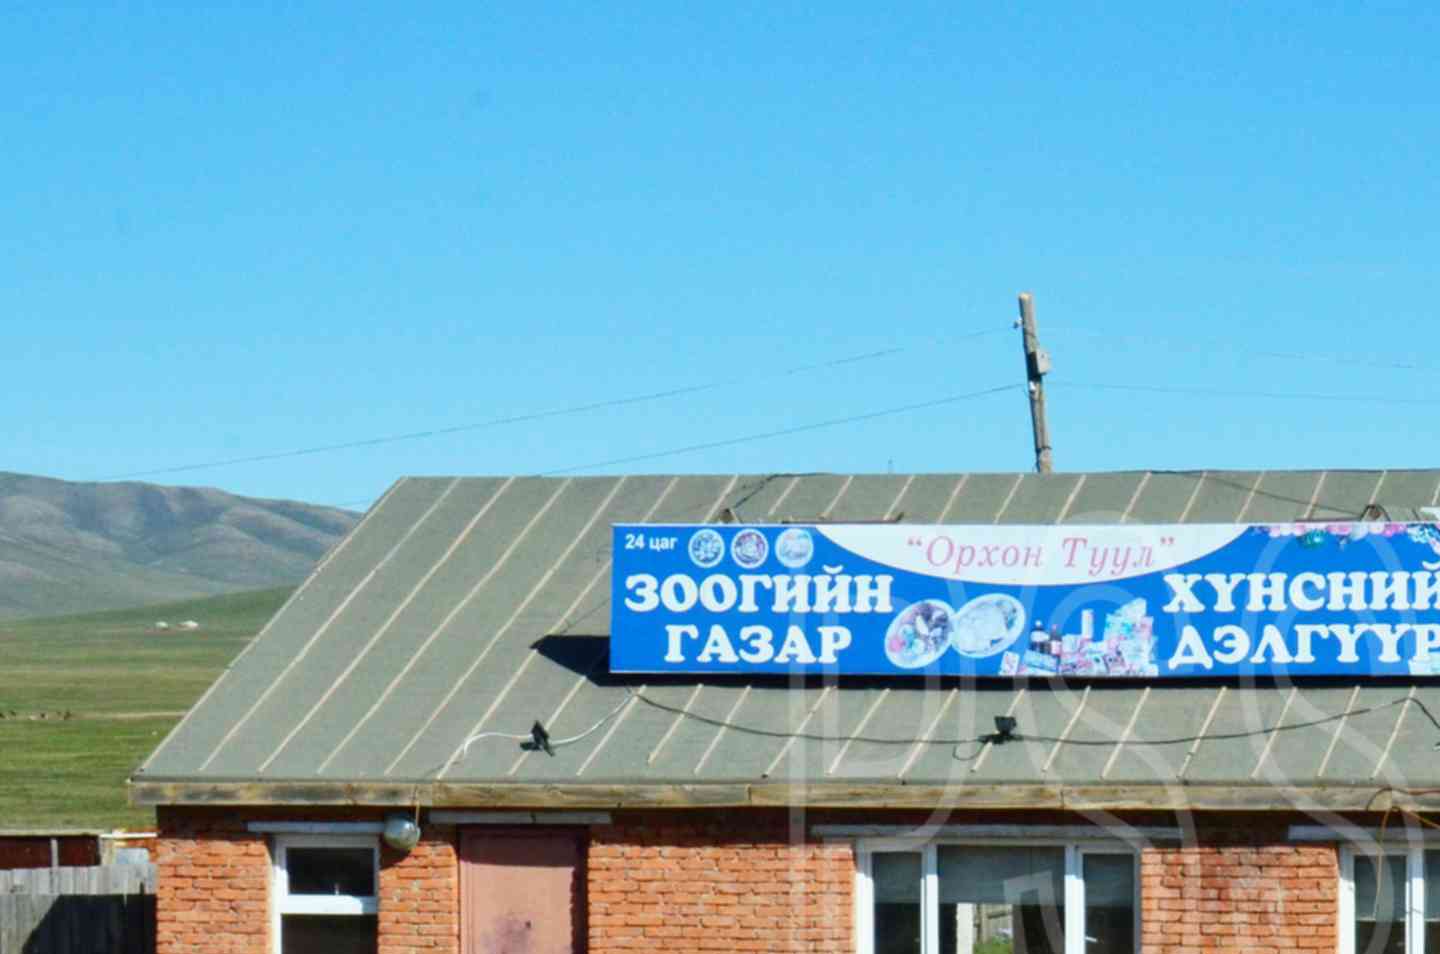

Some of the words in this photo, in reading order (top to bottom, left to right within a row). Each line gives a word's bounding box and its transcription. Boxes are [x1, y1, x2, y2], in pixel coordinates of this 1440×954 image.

[625, 533, 645, 550] 24
[649, 536, 677, 552] цаг
[624, 564, 894, 614] ЗООГИЙН
[664, 624, 852, 664] ГАЗАР
